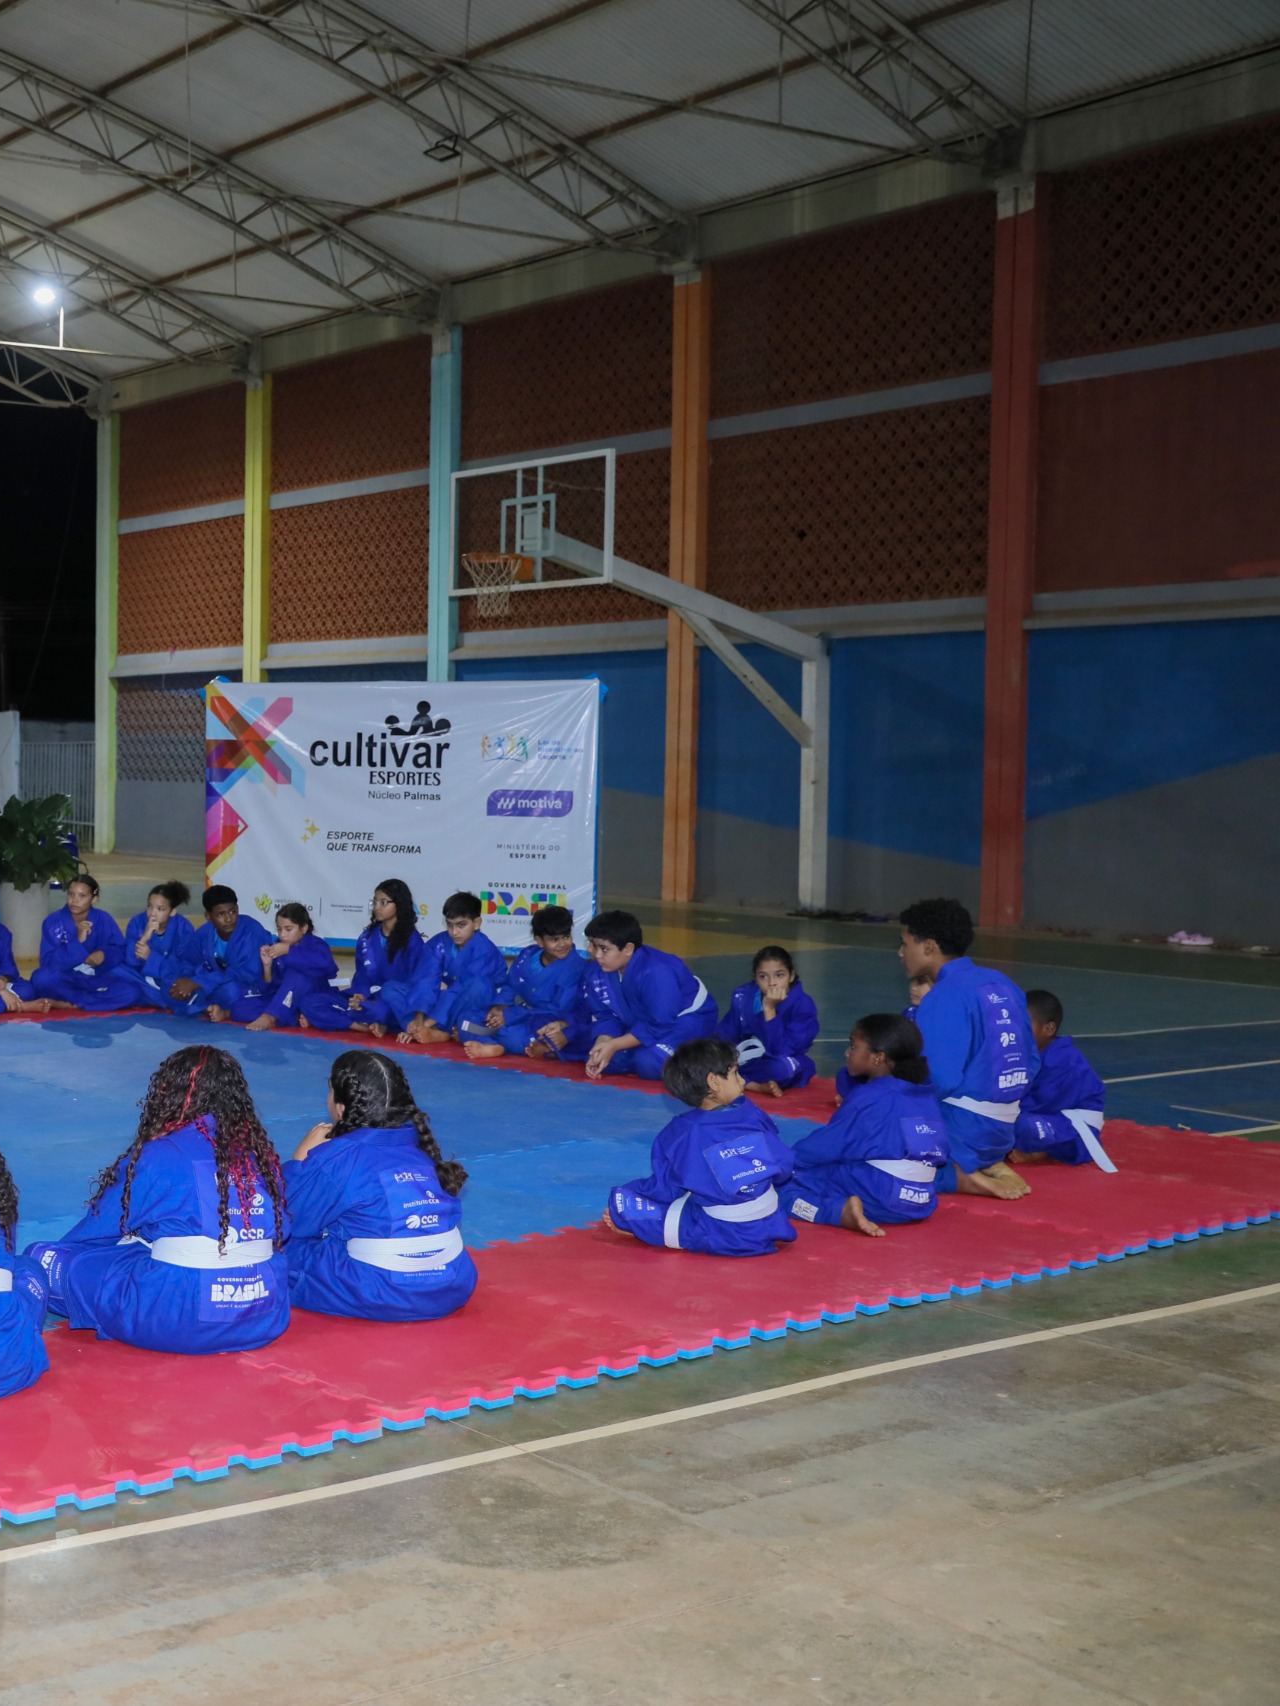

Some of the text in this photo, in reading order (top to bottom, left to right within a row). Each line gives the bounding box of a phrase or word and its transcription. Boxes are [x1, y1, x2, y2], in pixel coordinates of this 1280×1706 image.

[309, 732, 450, 768] cultivar
[369, 770, 442, 786] ESPORTES
[368, 790, 441, 801] Núcleo Palmas
[517, 796, 562, 809] motiva
[326, 831, 374, 841] ESPORTE
[326, 842, 422, 854] QUE TRANSFORMA
[496, 843, 545, 851] MINISTÉRIO
[754, 1165, 767, 1173] CCR
[899, 1187, 930, 1204] BRASIL
[250, 1207, 264, 1215] CCR
[421, 1215, 439, 1224] CCR
[239, 1228, 265, 1240] CCR
[211, 1280, 269, 1302] BRASIL
